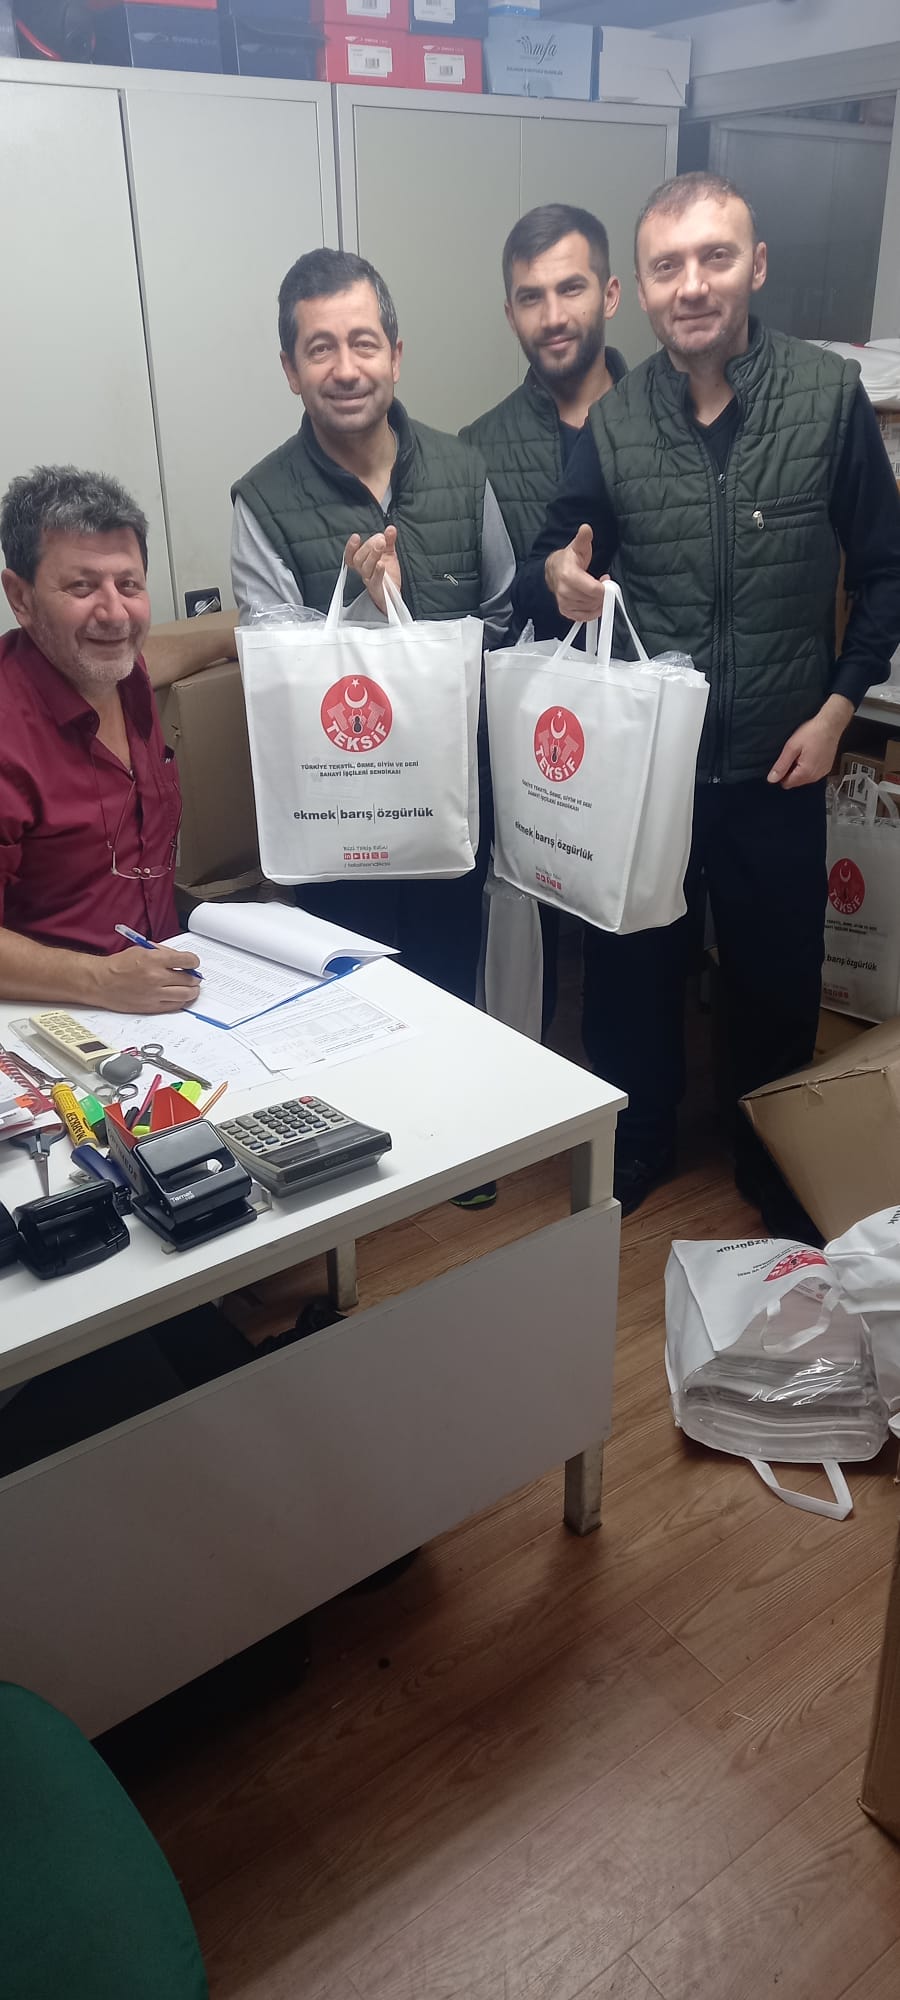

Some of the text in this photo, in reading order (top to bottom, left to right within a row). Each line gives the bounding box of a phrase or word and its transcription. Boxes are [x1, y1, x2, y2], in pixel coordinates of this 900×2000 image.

[326, 720, 387, 751] TEKSİF
[535, 745, 576, 780] TEKSİF
[293, 807, 434, 821] ekmek barış özgürlük
[515, 820, 593, 861] ekmek barış özgürlük
[829, 888, 861, 913] TEKSİF
[846, 957, 878, 971] özgürlük
[65, 1111, 88, 1141] MARKER
